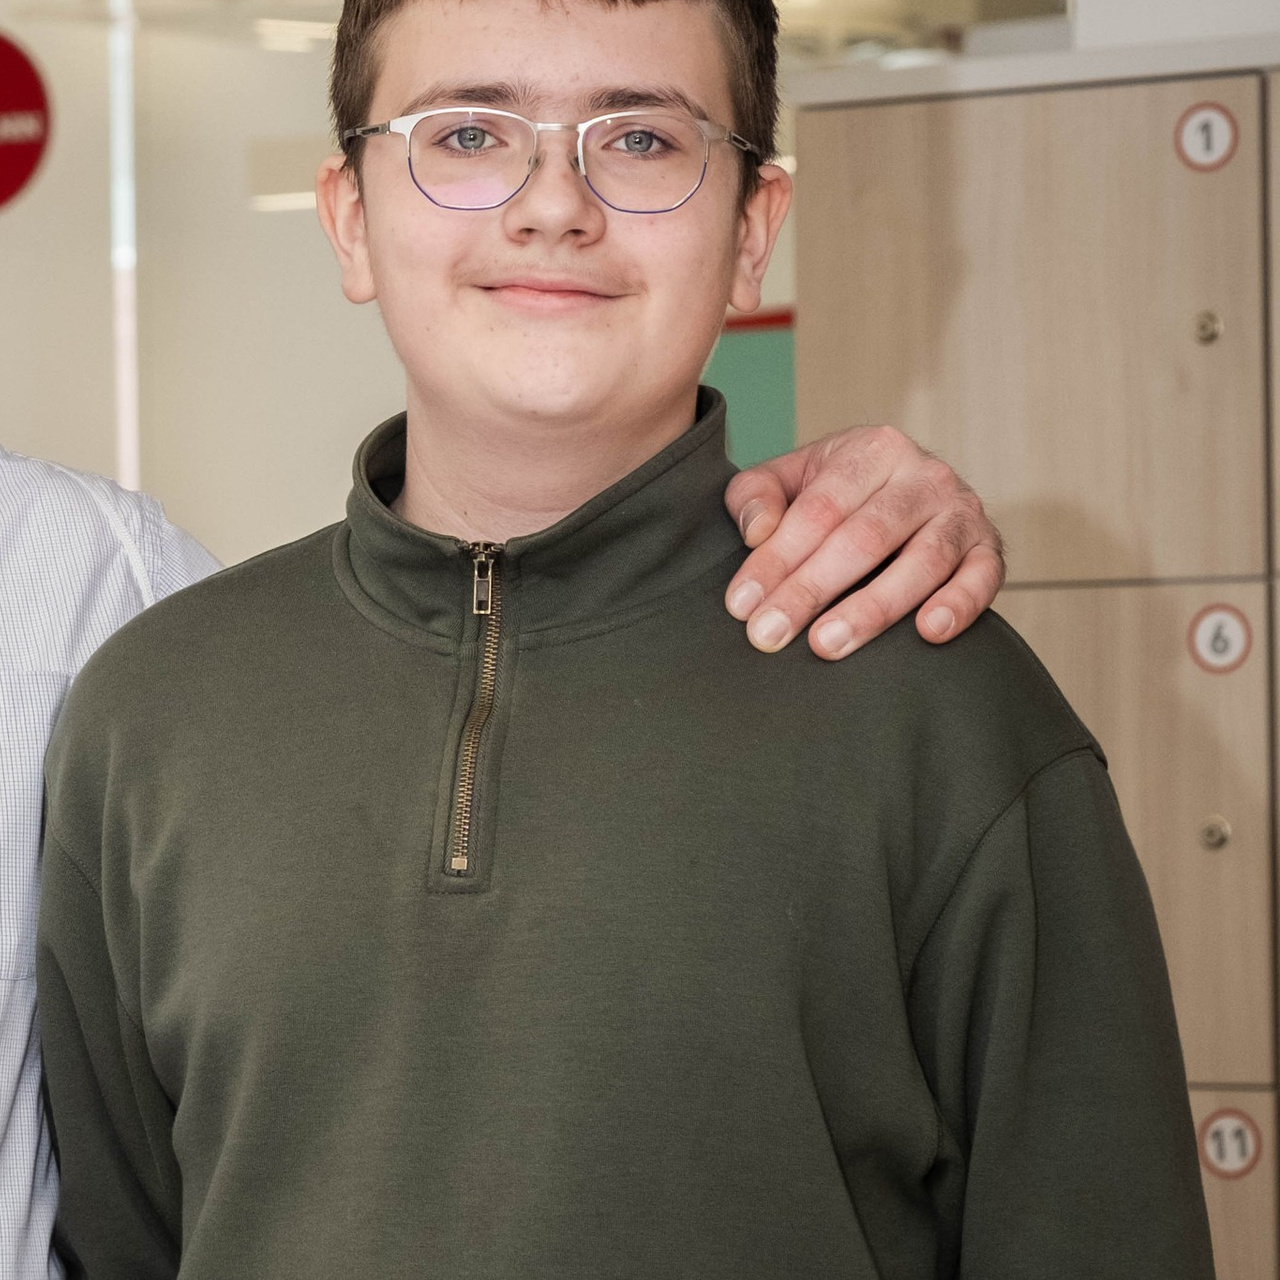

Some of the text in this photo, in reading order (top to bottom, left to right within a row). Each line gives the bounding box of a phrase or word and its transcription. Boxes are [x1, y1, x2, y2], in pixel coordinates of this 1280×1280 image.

[1198, 118, 1214, 153] 1
[1208, 622, 1231, 656] 6
[1211, 1126, 1248, 1161] 11
